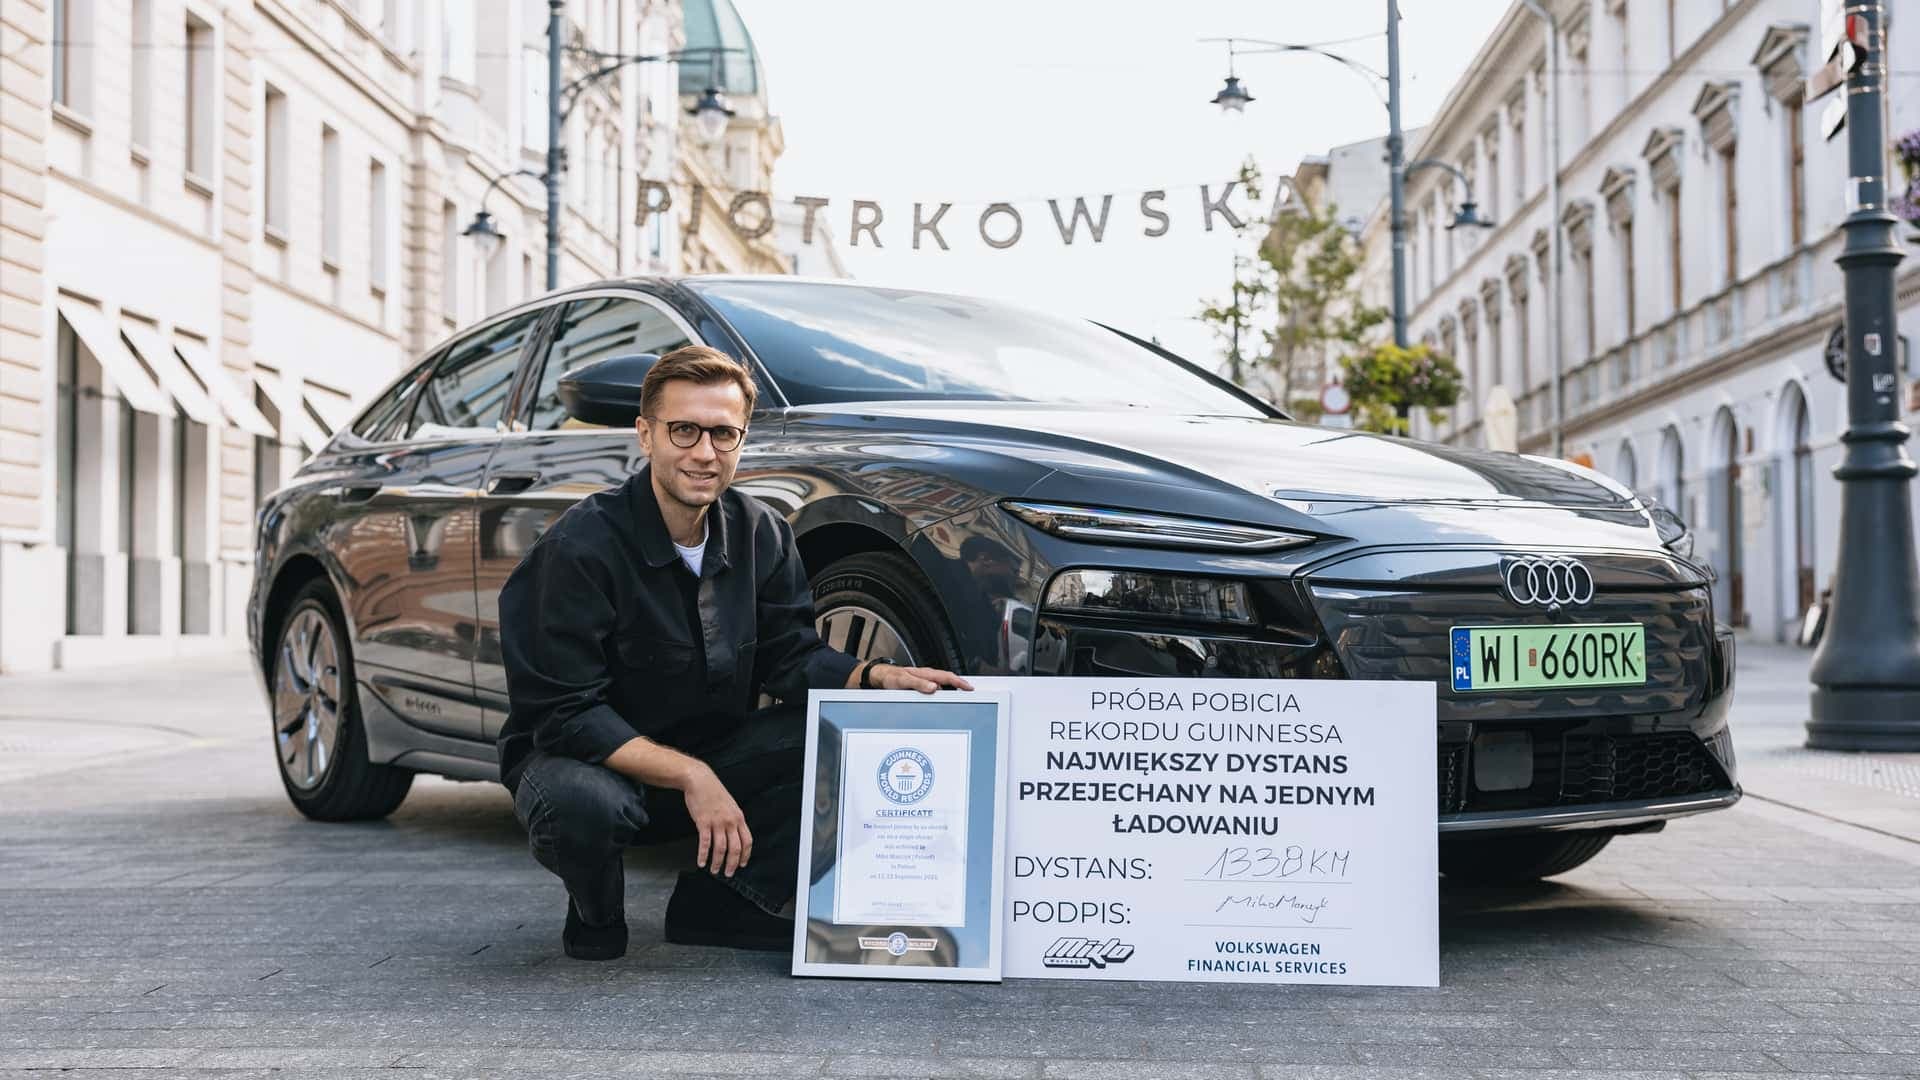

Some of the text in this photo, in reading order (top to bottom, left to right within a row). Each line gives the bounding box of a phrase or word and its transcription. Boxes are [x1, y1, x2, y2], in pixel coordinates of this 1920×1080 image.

[635, 174, 1313, 250] PIOTRKOWSKA
[1456, 667, 1469, 680] PL
[1091, 688, 1301, 713] PRÓBA POBICIA
[1050, 721, 1342, 744] REKORDU GUINNESSA
[886, 750, 928, 767] GUINNESS
[1046, 751, 1348, 776] NAJWIĘKSZY DYSTANS
[880, 772, 932, 803] WORLD RECORDS
[1019, 781, 1375, 807] PRZEJECHANY NA JEDNYM
[875, 808, 934, 818] CERTIFICATE
[1112, 813, 1279, 836] ŁADOWANIU
[1014, 855, 1153, 881] DYSTANS:
[1309, 848, 1350, 877] KM
[1012, 900, 1132, 925] PODPIS:
[1215, 940, 1321, 956] VOLKSWAGEN
[1188, 958, 1347, 975] FINANCIAL SERVICES
